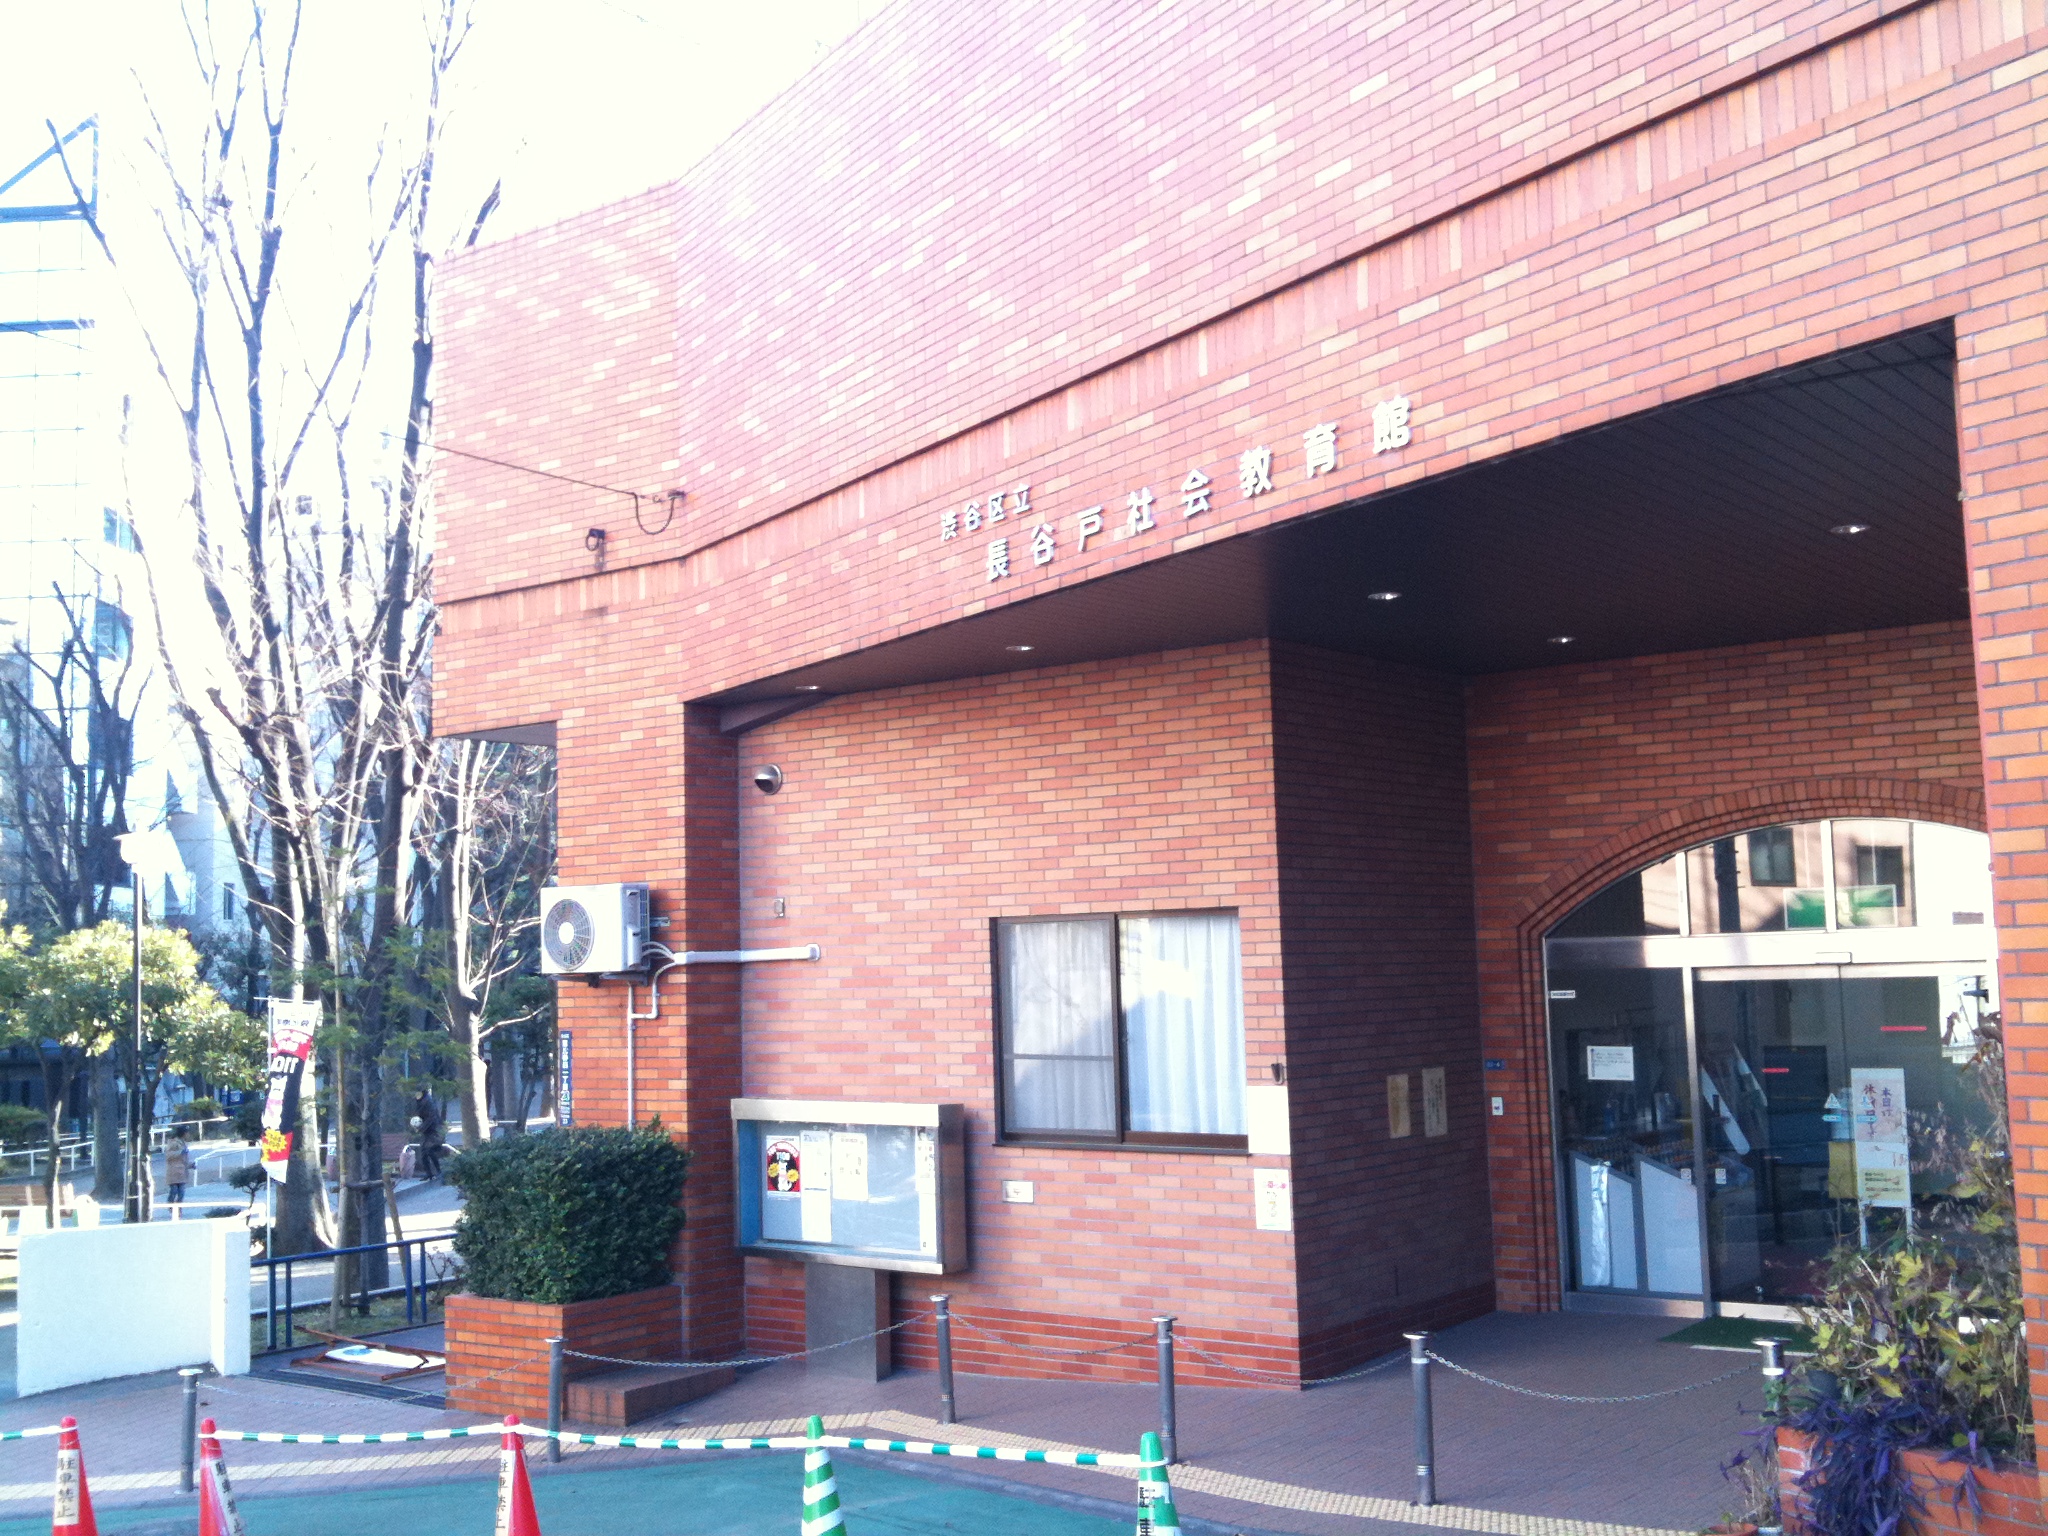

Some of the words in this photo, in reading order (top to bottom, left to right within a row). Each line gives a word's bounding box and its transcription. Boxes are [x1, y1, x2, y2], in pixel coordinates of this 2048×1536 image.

[985, 393, 1413, 583] 長谷戸社会教育館
[55, 1457, 76, 1519] 駐車禁止
